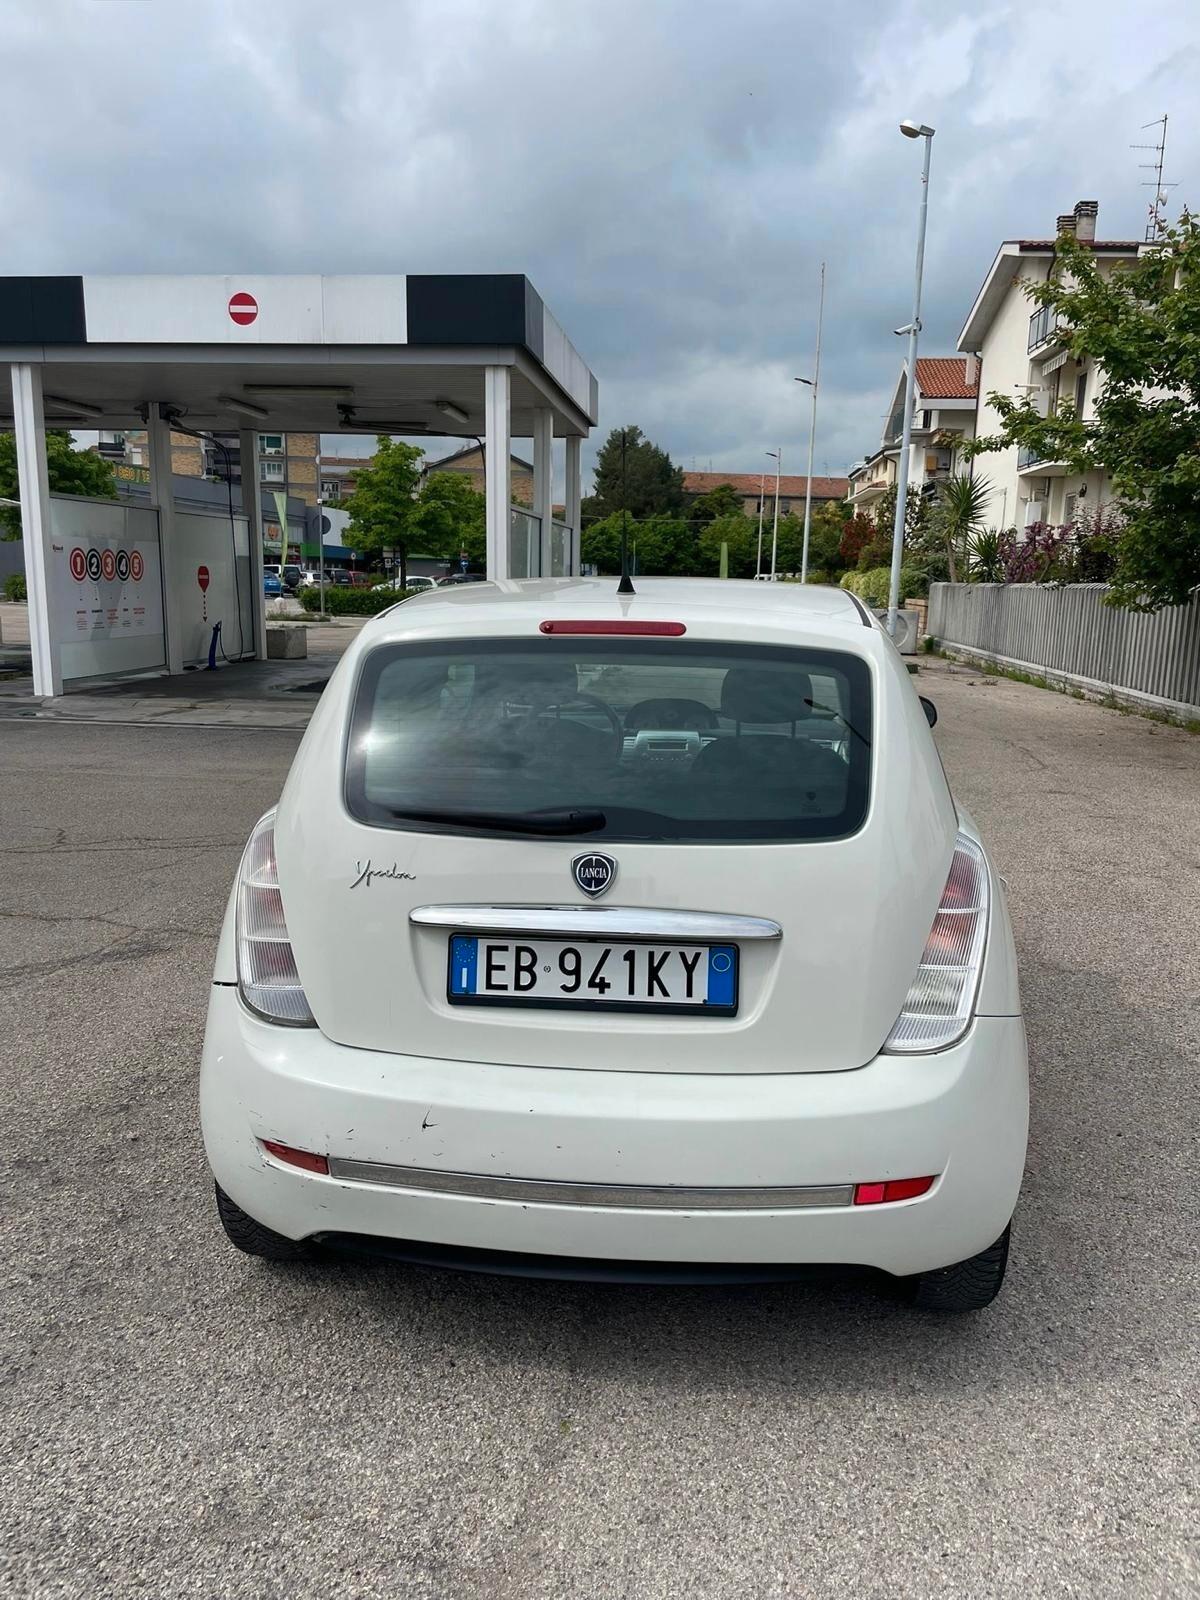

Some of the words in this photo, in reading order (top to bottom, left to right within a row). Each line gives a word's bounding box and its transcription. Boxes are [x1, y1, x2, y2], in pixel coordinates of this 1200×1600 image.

[76, 557, 81, 572] 1
[91, 557, 97, 572] 2
[106, 557, 112, 572] 3
[120, 558, 126, 573] 4
[133, 558, 139, 572] 5
[349, 859, 416, 889] Ypsilon
[580, 867, 607, 879] LANCIA
